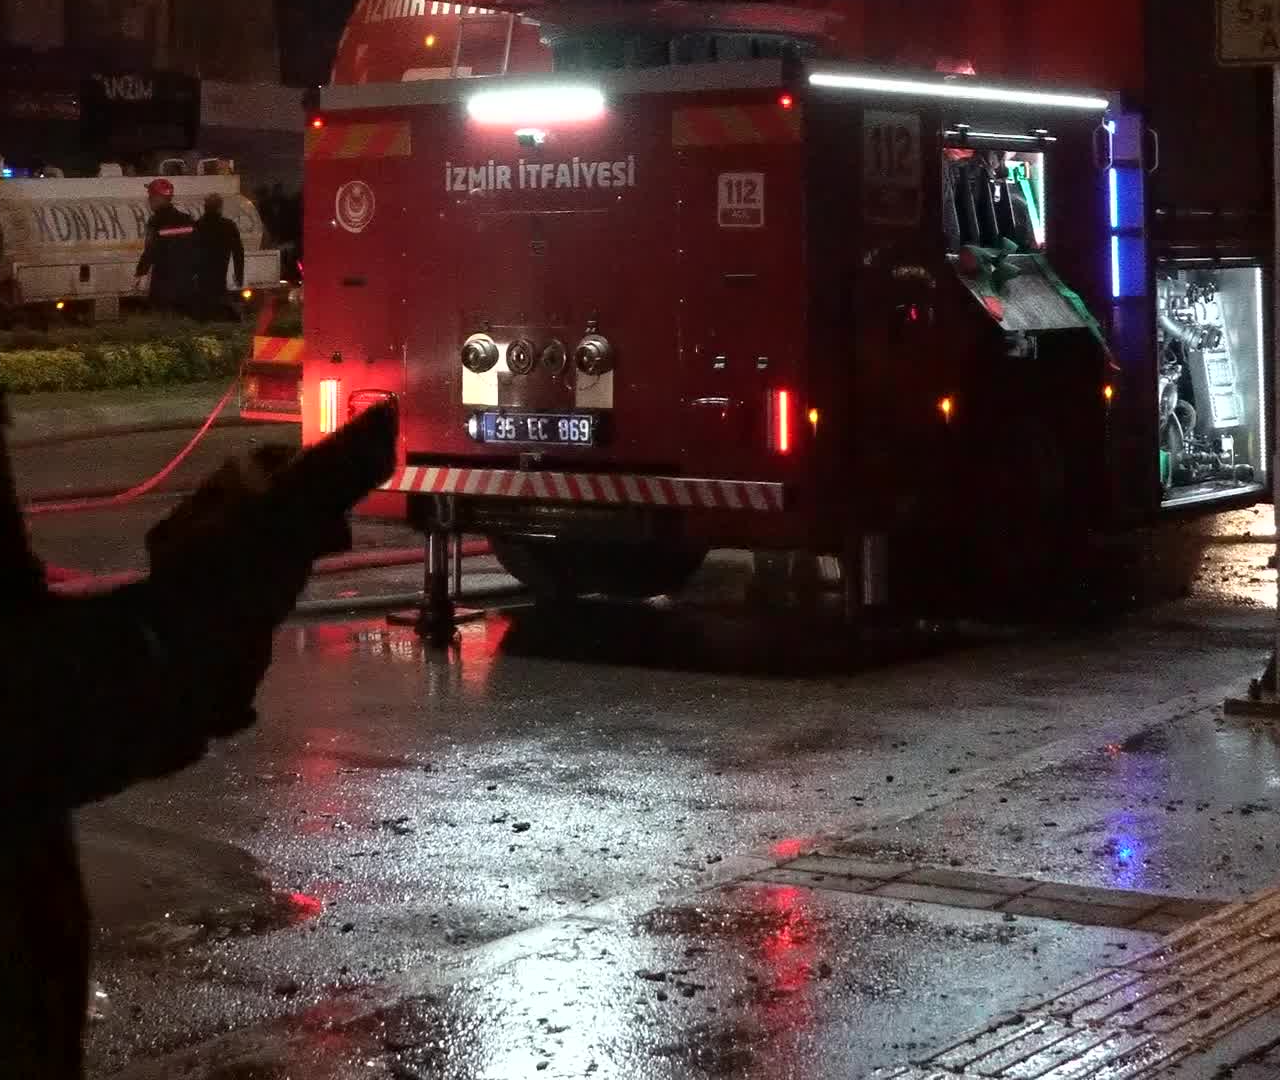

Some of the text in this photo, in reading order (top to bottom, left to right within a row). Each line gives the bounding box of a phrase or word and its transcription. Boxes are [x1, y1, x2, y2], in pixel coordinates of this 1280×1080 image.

[445, 155, 635, 192] İZMİR İTFAİYESİ
[724, 178, 758, 205] 112
[32, 203, 125, 243] KONAK
[496, 416, 516, 440] 35
[527, 416, 548, 441] EC
